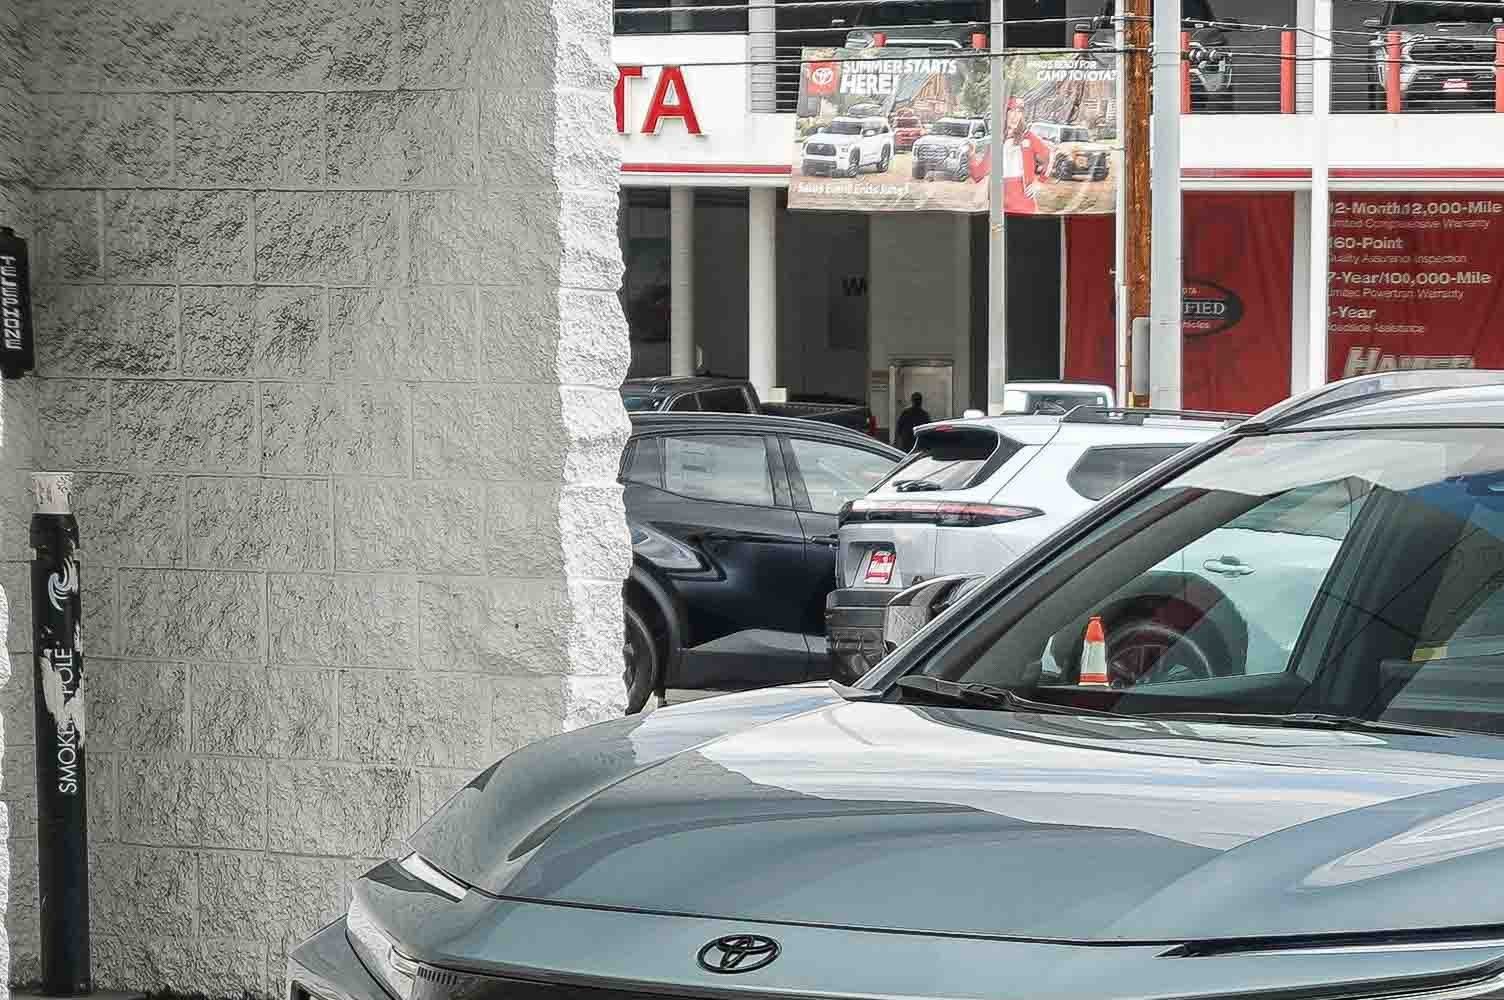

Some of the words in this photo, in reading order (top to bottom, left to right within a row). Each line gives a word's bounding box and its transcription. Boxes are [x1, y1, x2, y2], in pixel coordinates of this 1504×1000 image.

[842, 60, 903, 74] SUMMER
[904, 59, 958, 73] STARTS
[1079, 60, 1097, 69] FOR
[840, 73, 898, 95] HERE!
